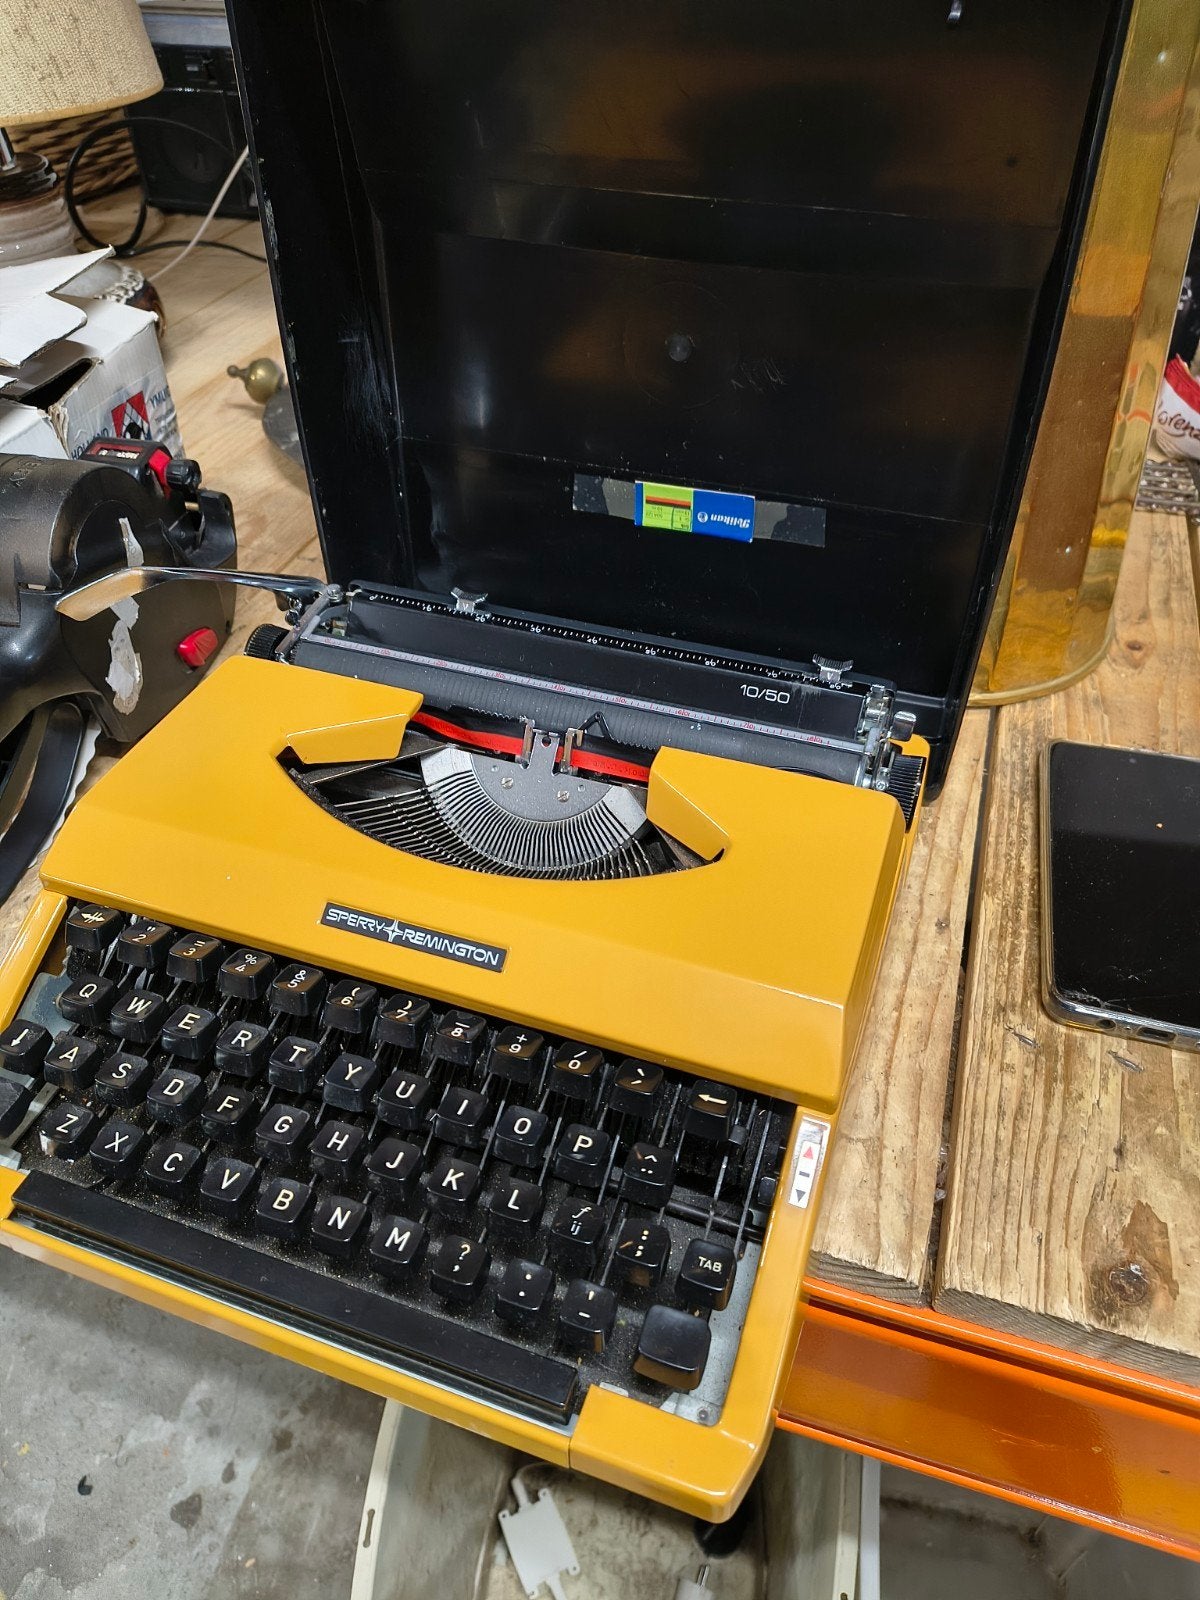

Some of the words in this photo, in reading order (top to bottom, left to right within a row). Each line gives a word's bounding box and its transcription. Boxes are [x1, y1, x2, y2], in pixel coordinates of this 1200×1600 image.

[710, 513, 751, 529] Pelikan
[740, 684, 791, 704] 10/50
[131, 933, 147, 943] 2
[326, 908, 386, 933] SPERRY
[402, 929, 501, 966] REMINGTON
[80, 984, 97, 998] Q
[127, 997, 151, 1013] W
[340, 996, 354, 1006] 6
[178, 1013, 200, 1029] E
[395, 1007, 409, 1019] 7
[232, 1030, 252, 1047] R
[450, 1027, 463, 1037] 8
[59, 1047, 78, 1062] A
[289, 1046, 306, 1062] T
[508, 1043, 522, 1054] 9
[113, 1063, 131, 1078] S
[345, 1063, 362, 1080] Y
[163, 1079, 184, 1095] D
[396, 1081, 415, 1098] U
[217, 1096, 239, 1111] F
[56, 1114, 78, 1133] Z
[274, 1116, 293, 1132] G
[514, 1118, 531, 1134] O
[105, 1132, 128, 1152] X
[327, 1132, 349, 1150] H
[573, 1135, 592, 1151] P
[164, 1153, 182, 1171] C
[386, 1152, 404, 1168] J
[222, 1169, 240, 1189] V
[442, 1169, 464, 1190] K
[273, 1189, 293, 1210] B
[507, 1189, 520, 1210] L
[328, 1207, 351, 1229] N
[385, 1227, 410, 1251] M
[699, 1257, 721, 1272] TAB
